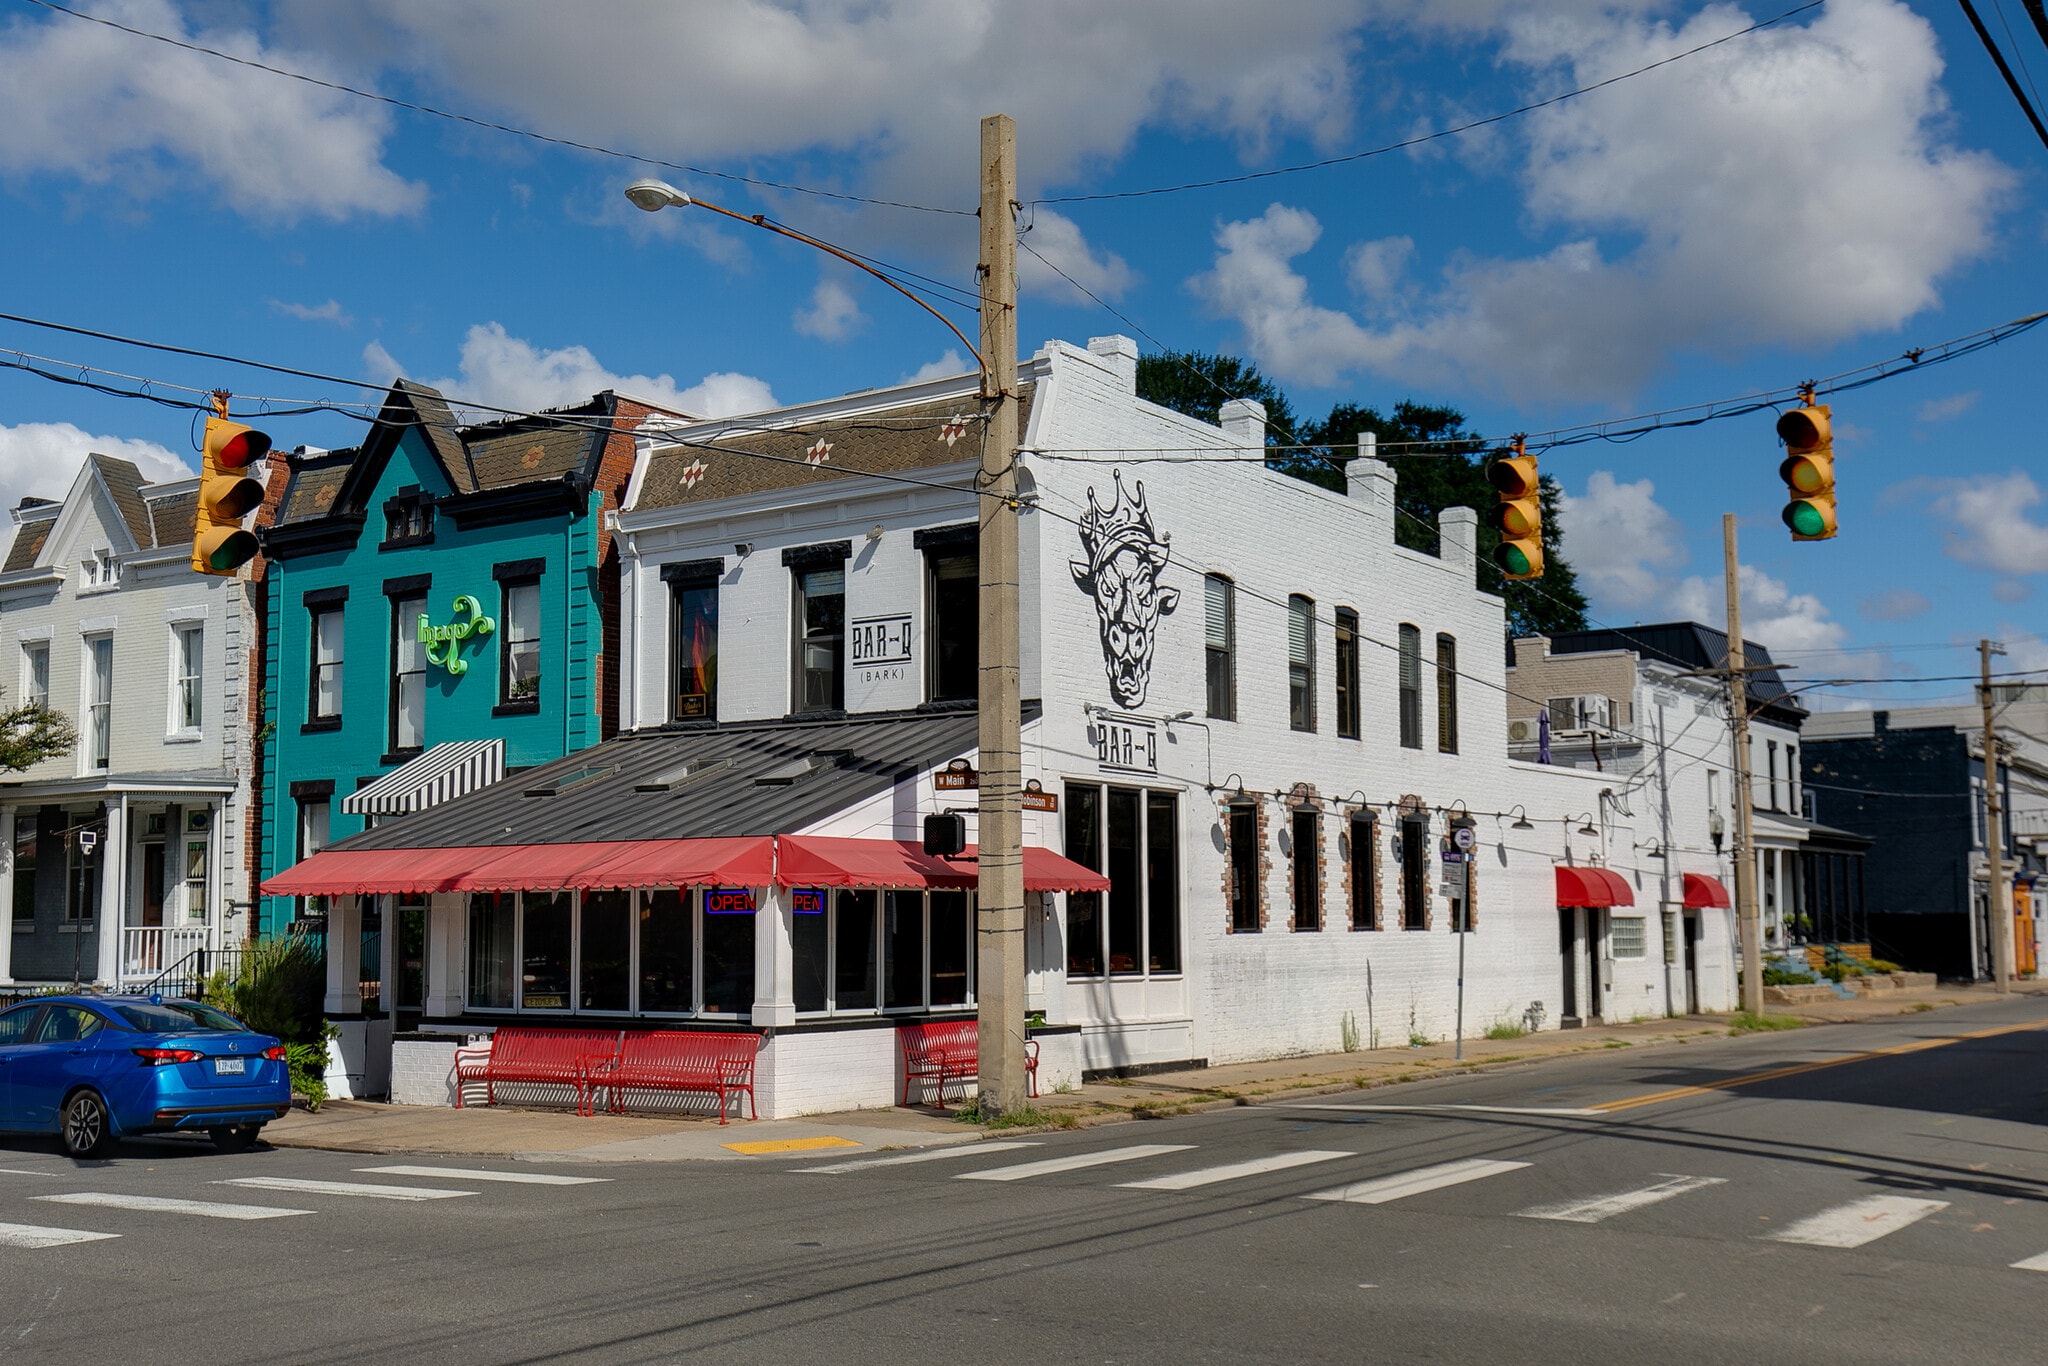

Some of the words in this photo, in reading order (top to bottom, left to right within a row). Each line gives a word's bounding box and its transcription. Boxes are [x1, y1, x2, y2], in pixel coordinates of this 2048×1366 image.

[852, 622, 912, 659] BAR-Q
[860, 668, 904, 684] (BARK)
[1097, 723, 1158, 771] BAR-Q
[938, 776, 945, 785] W
[946, 774, 966, 786] Main
[709, 894, 757, 911] OPEN
[794, 895, 821, 911] PEN
